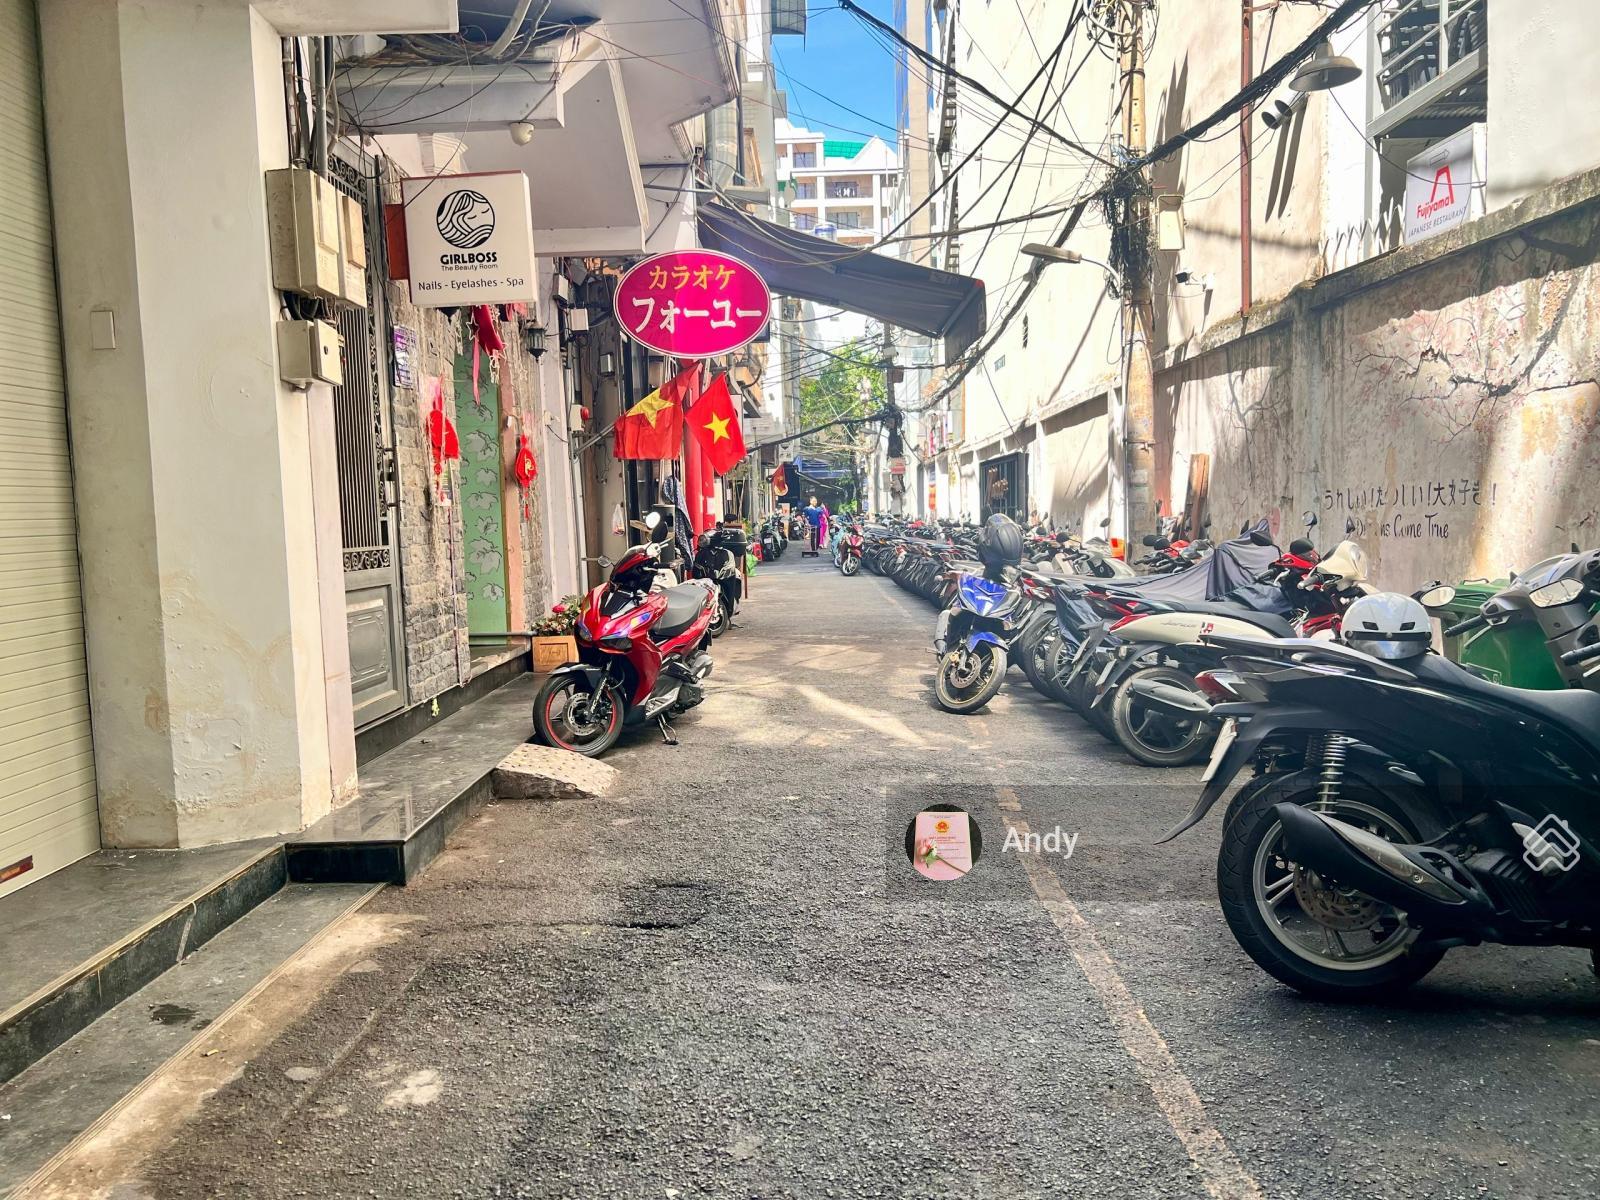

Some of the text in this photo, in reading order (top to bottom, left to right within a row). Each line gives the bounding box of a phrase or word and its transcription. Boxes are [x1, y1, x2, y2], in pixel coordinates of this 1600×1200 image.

[1417, 196, 1450, 219] Fujiyama
[1408, 207, 1466, 238] JAPANESE RESTAURANT
[440, 252, 498, 265] GIRLBOSS
[454, 264, 478, 272] Beauty
[418, 281, 442, 291] Nails
[451, 278, 498, 290] Eyelashes
[506, 277, 524, 288] Spa
[648, 264, 736, 290] カラオケ
[632, 297, 762, 334] フォーユー
[1424, 512, 1449, 539] True
